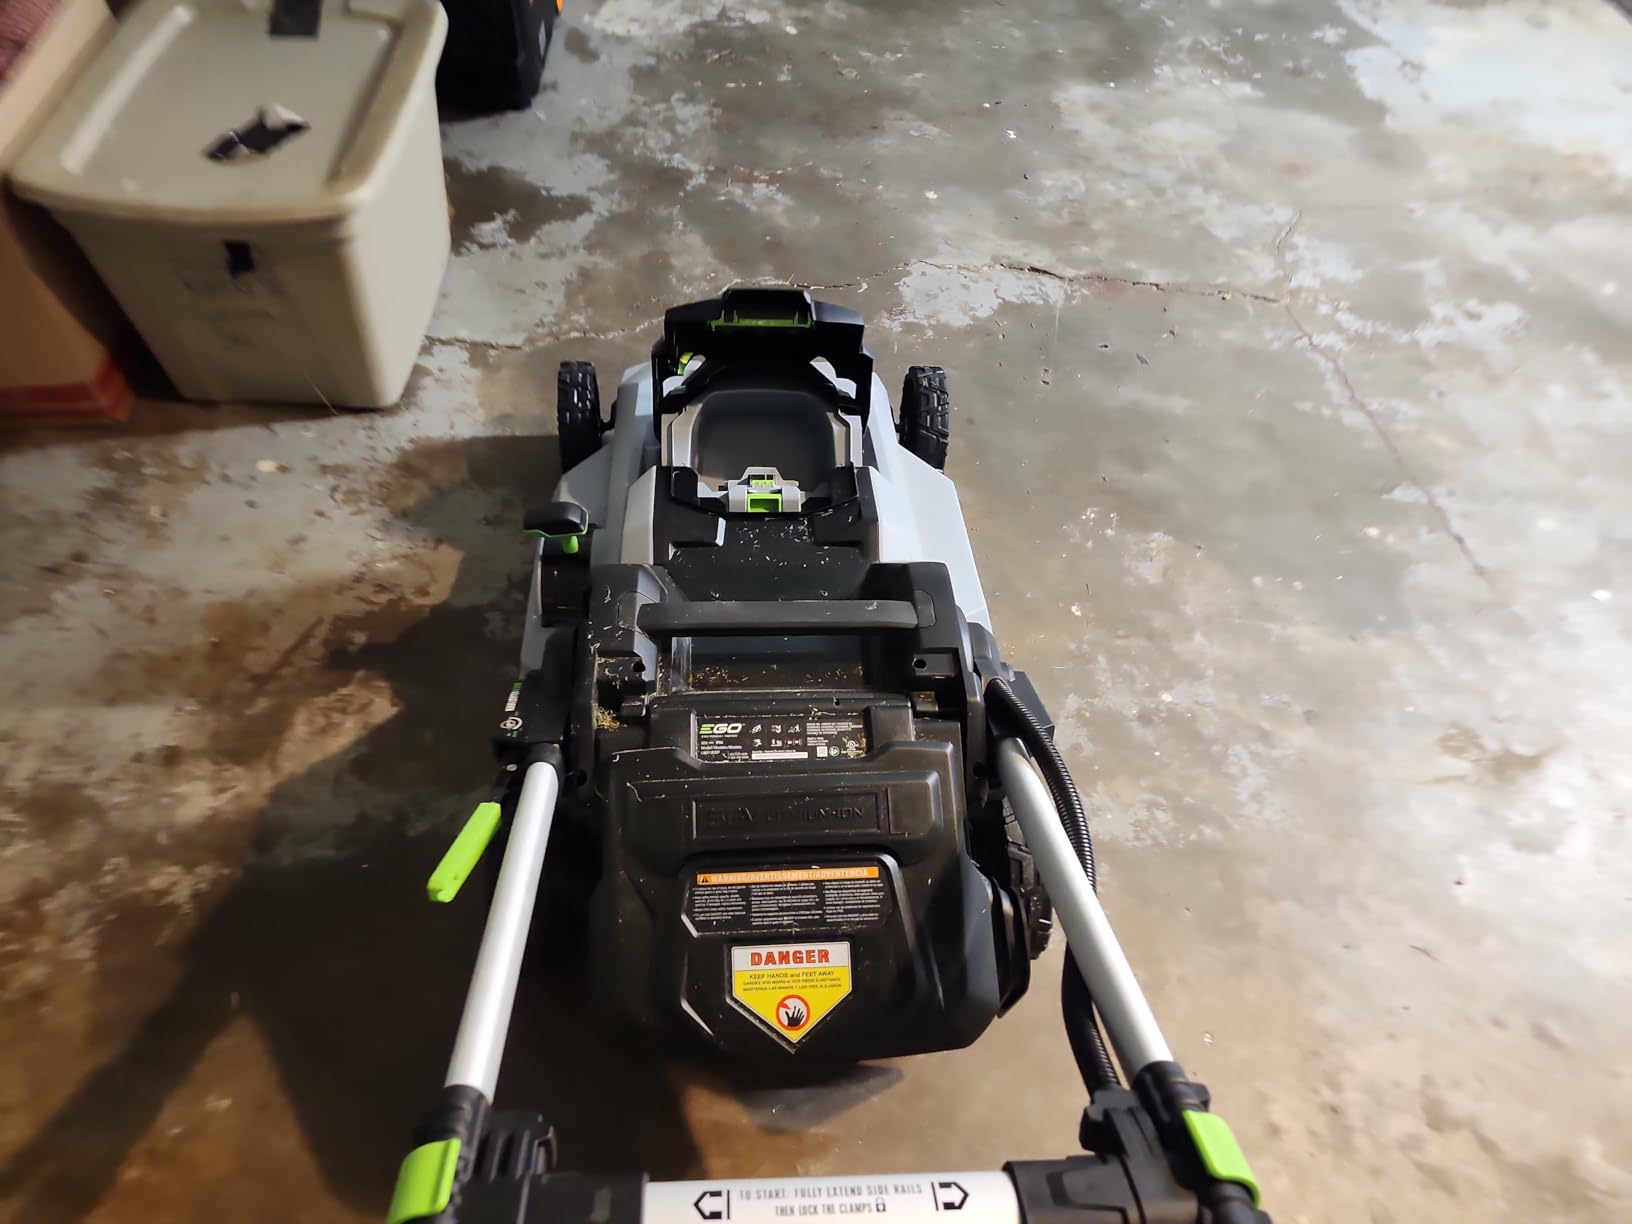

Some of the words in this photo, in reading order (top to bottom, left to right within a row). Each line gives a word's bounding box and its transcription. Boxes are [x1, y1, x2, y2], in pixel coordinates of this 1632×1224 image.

[699, 723, 742, 734] EGO
[751, 949, 830, 966] DANGER
[740, 1189, 750, 1200] TO
[794, 1187, 822, 1198] FULLY
[827, 1186, 862, 1198] EXTEND
[867, 1185, 889, 1196] SIDE
[894, 1184, 922, 1195] RAILS
[775, 1205, 795, 1216] THEN
[799, 1204, 819, 1215] LOCK
[822, 1204, 835, 1214] THE
[839, 1203, 872, 1214] CLAMPS
